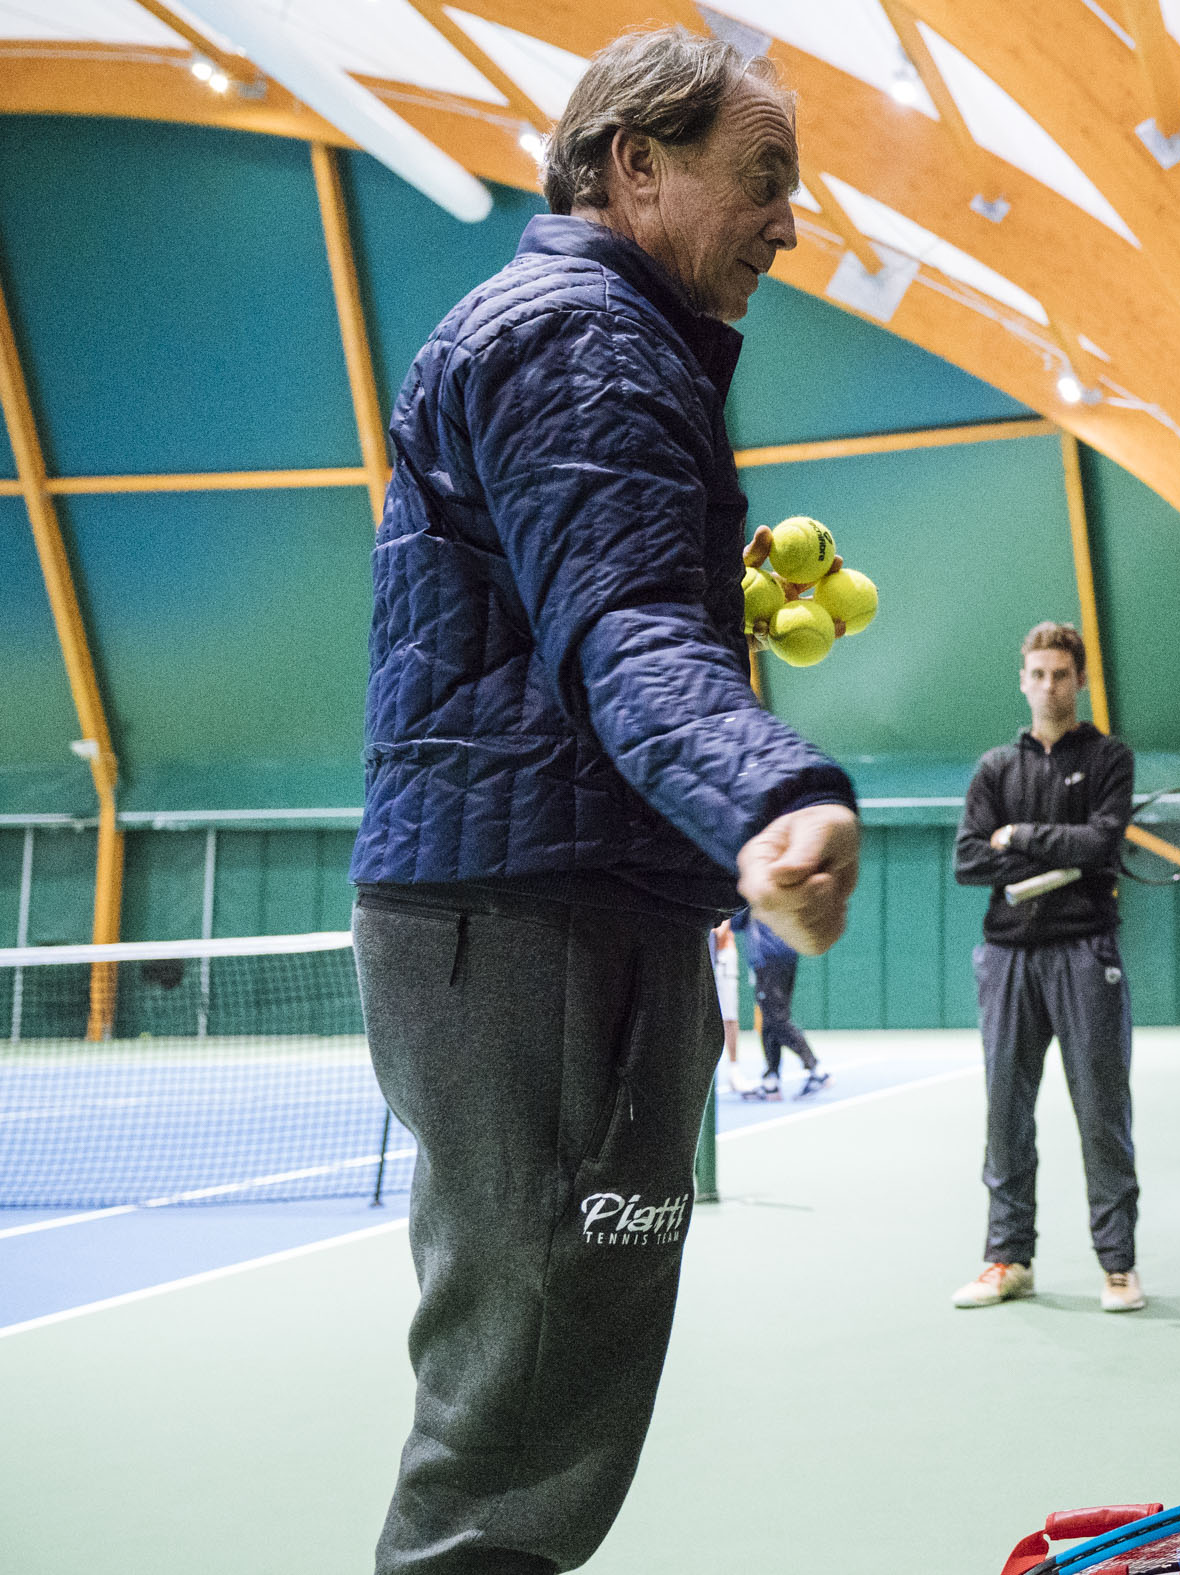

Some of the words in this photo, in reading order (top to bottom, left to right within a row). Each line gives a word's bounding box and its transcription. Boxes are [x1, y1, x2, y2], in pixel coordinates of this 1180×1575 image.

[581, 1192, 689, 1235] Piatti
[585, 1231, 649, 1246] TENNIS
[656, 1230, 680, 1245] TEAM
